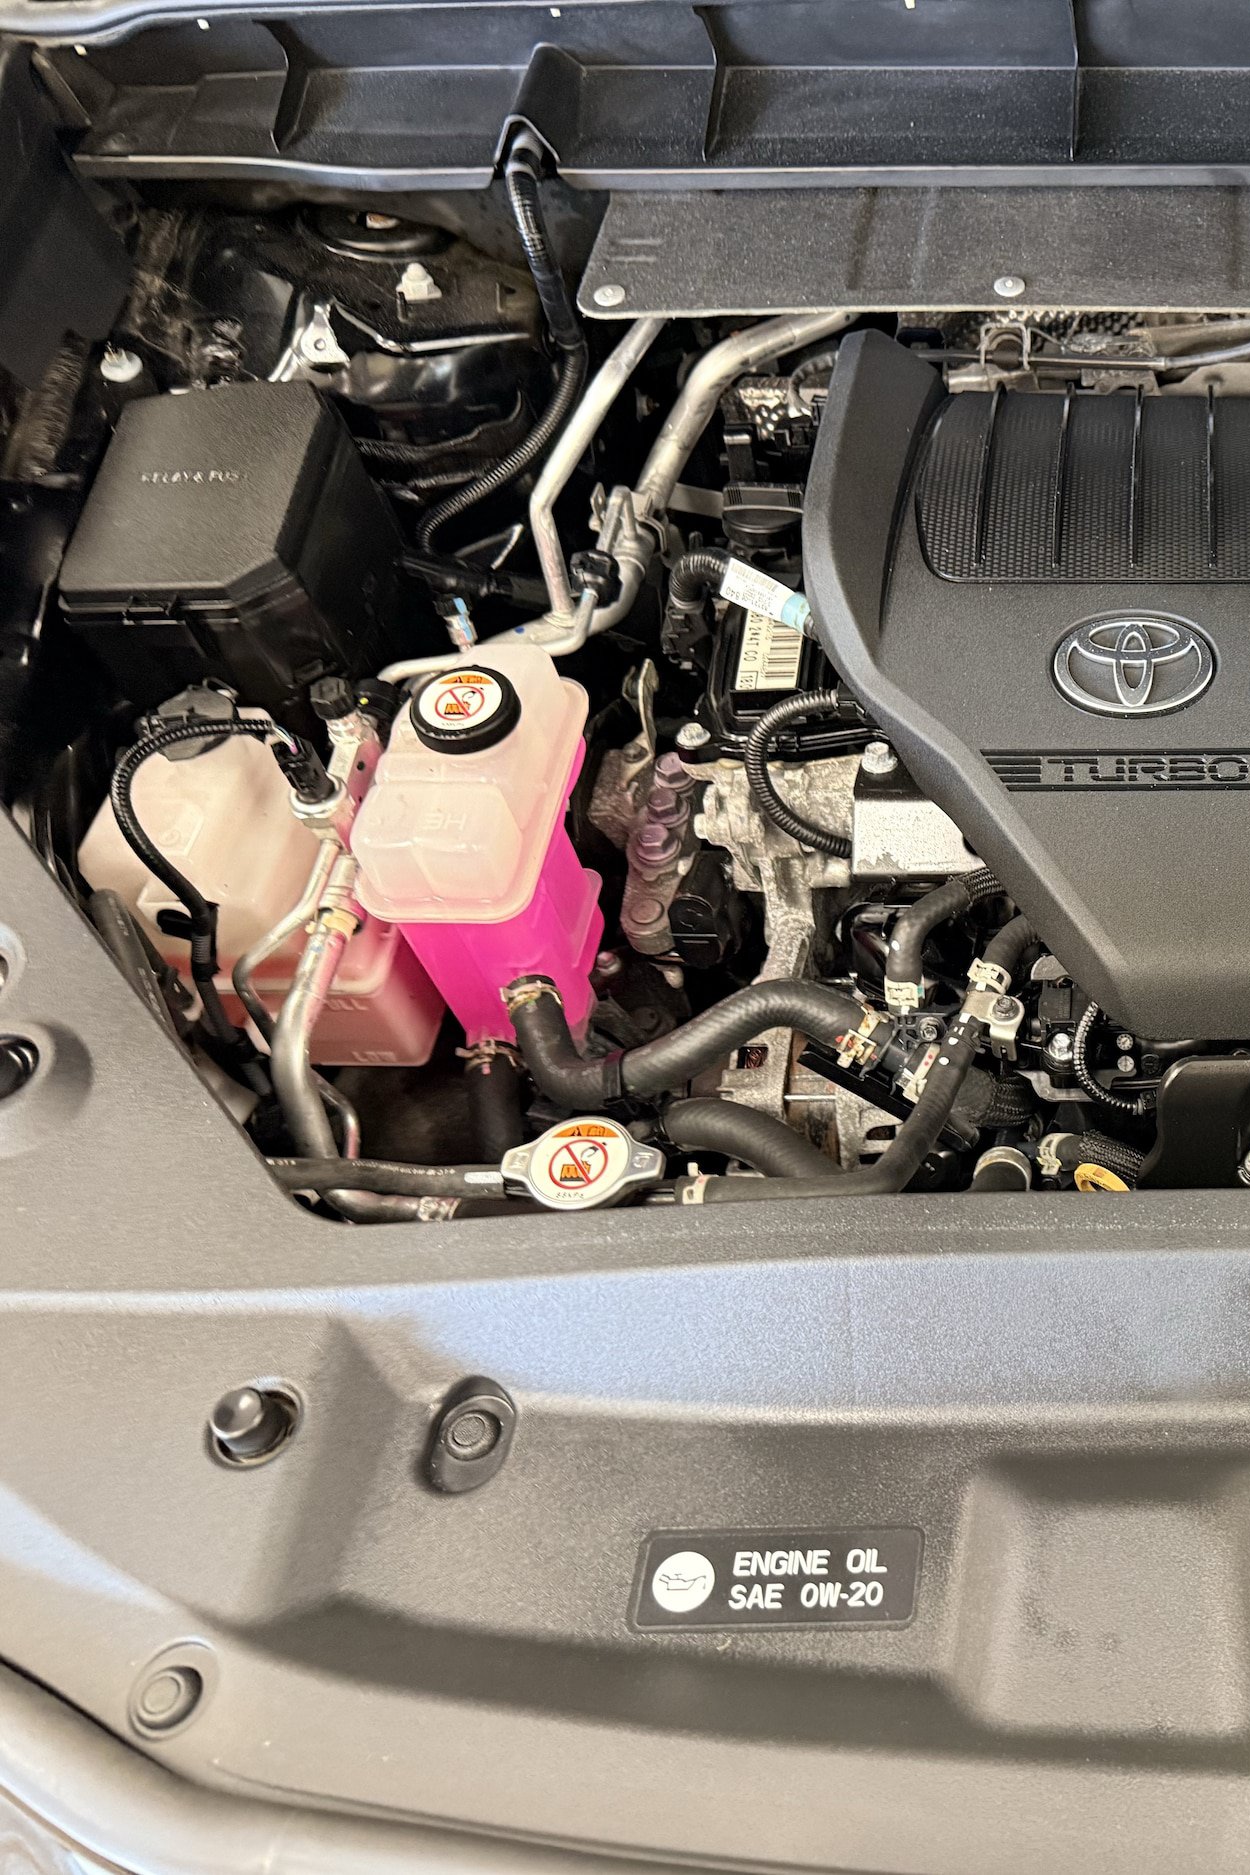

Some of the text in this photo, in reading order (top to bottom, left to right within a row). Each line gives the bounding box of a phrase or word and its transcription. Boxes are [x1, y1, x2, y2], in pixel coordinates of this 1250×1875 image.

[1046, 755, 1249, 782] TURBO
[732, 1548, 888, 1577] ENGINE OIL
[727, 1581, 884, 1610] SAE 0W-20
